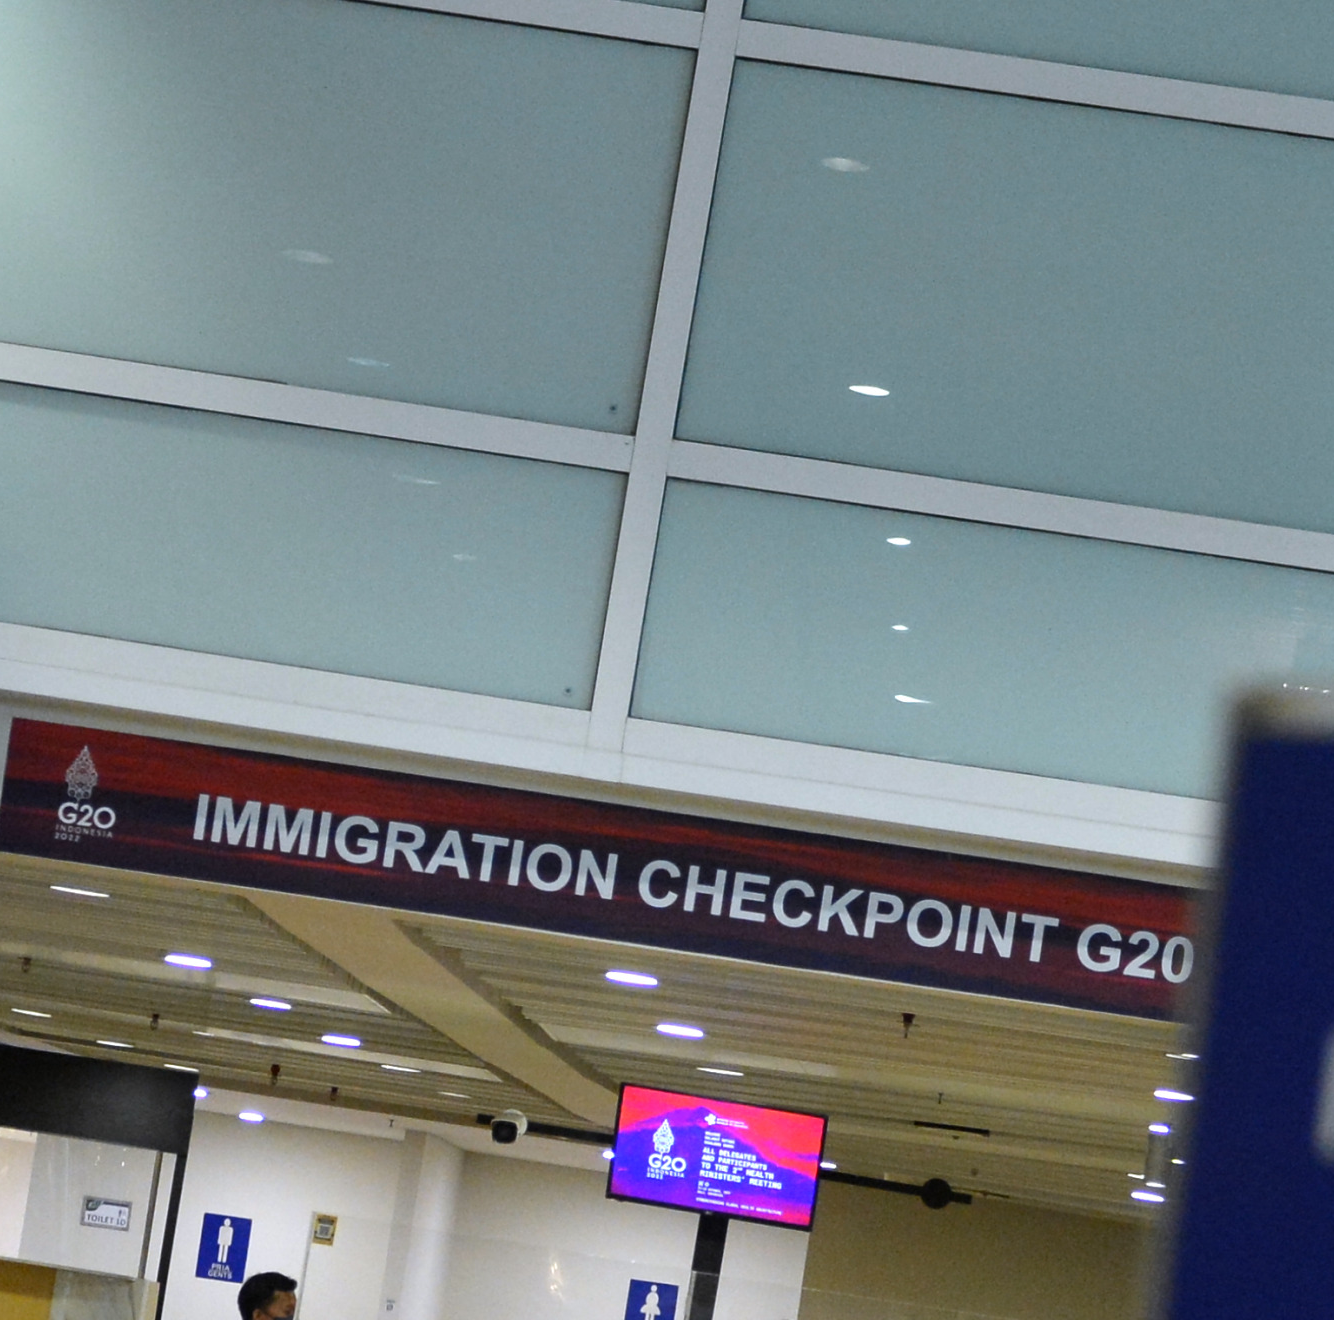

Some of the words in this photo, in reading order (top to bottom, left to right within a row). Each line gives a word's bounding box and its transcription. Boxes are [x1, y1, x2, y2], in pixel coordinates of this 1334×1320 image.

[58, 802, 116, 829] G20
[54, 832, 80, 842] 2022
[55, 824, 113, 838] INDONESIA
[193, 793, 618, 900] IMMIGRATION
[638, 859, 1059, 963] CHECKPOINT
[1076, 923, 1195, 984] G20
[702, 1147, 715, 1155] ALL
[719, 1149, 756, 1161] DELEGATES
[648, 1153, 686, 1172] G20
[701, 1154, 715, 1162] AND
[718, 1157, 767, 1170] PARTICIPANTS
[701, 1161, 711, 1169] TO
[714, 1163, 729, 1172] THE
[746, 1169, 774, 1180] HEALTH
[749, 1178, 782, 1190] MEETING
[86, 1214, 114, 1224] TOILET
